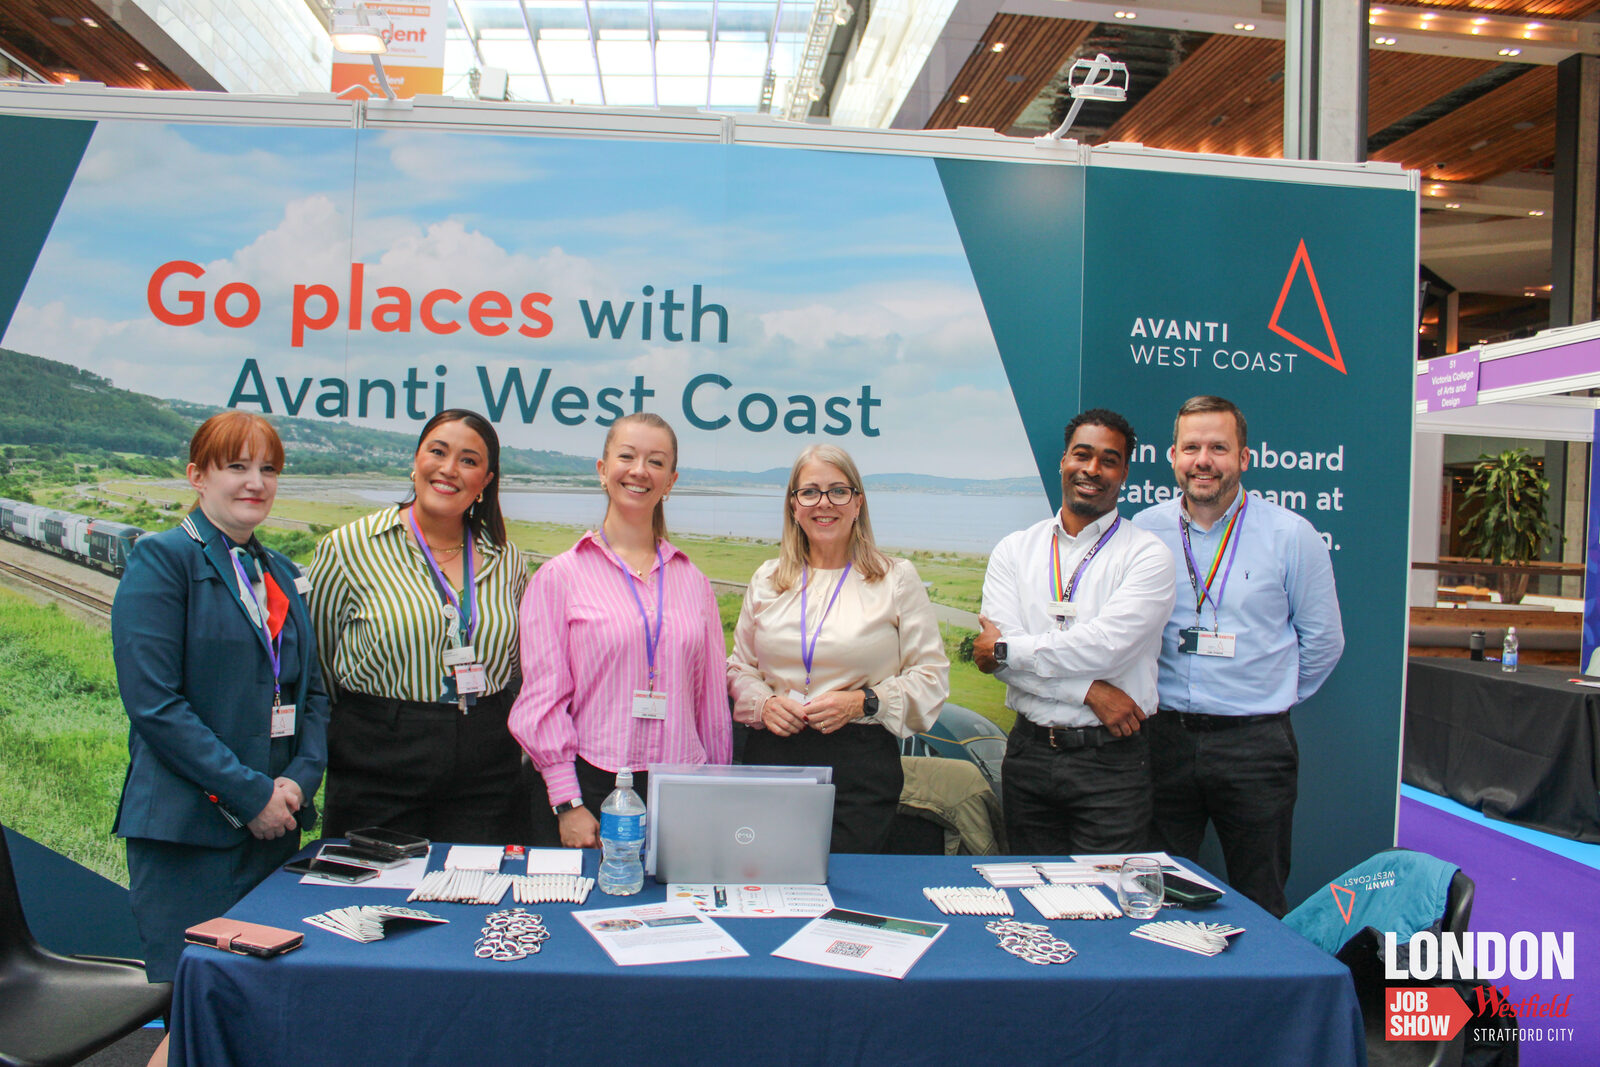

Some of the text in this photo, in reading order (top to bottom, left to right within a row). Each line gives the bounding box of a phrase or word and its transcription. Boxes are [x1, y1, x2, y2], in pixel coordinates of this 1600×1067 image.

[381, 23, 427, 43] dent
[147, 260, 729, 347] Go places with
[1130, 317, 1228, 343] AVANTI
[1130, 344, 1298, 373] WEST COAST
[1431, 371, 1474, 386] Victoria College
[1437, 383, 1467, 396] of Arts and
[227, 358, 882, 437] Avanti West Coast
[1441, 398, 1460, 408] Design
[1131, 436, 1156, 463] in
[1248, 442, 1344, 472] nboard
[1117, 479, 1344, 511] cater eam at
[1343, 870, 1396, 887] WEST COAST
[1365, 878, 1396, 891] AVANTI
